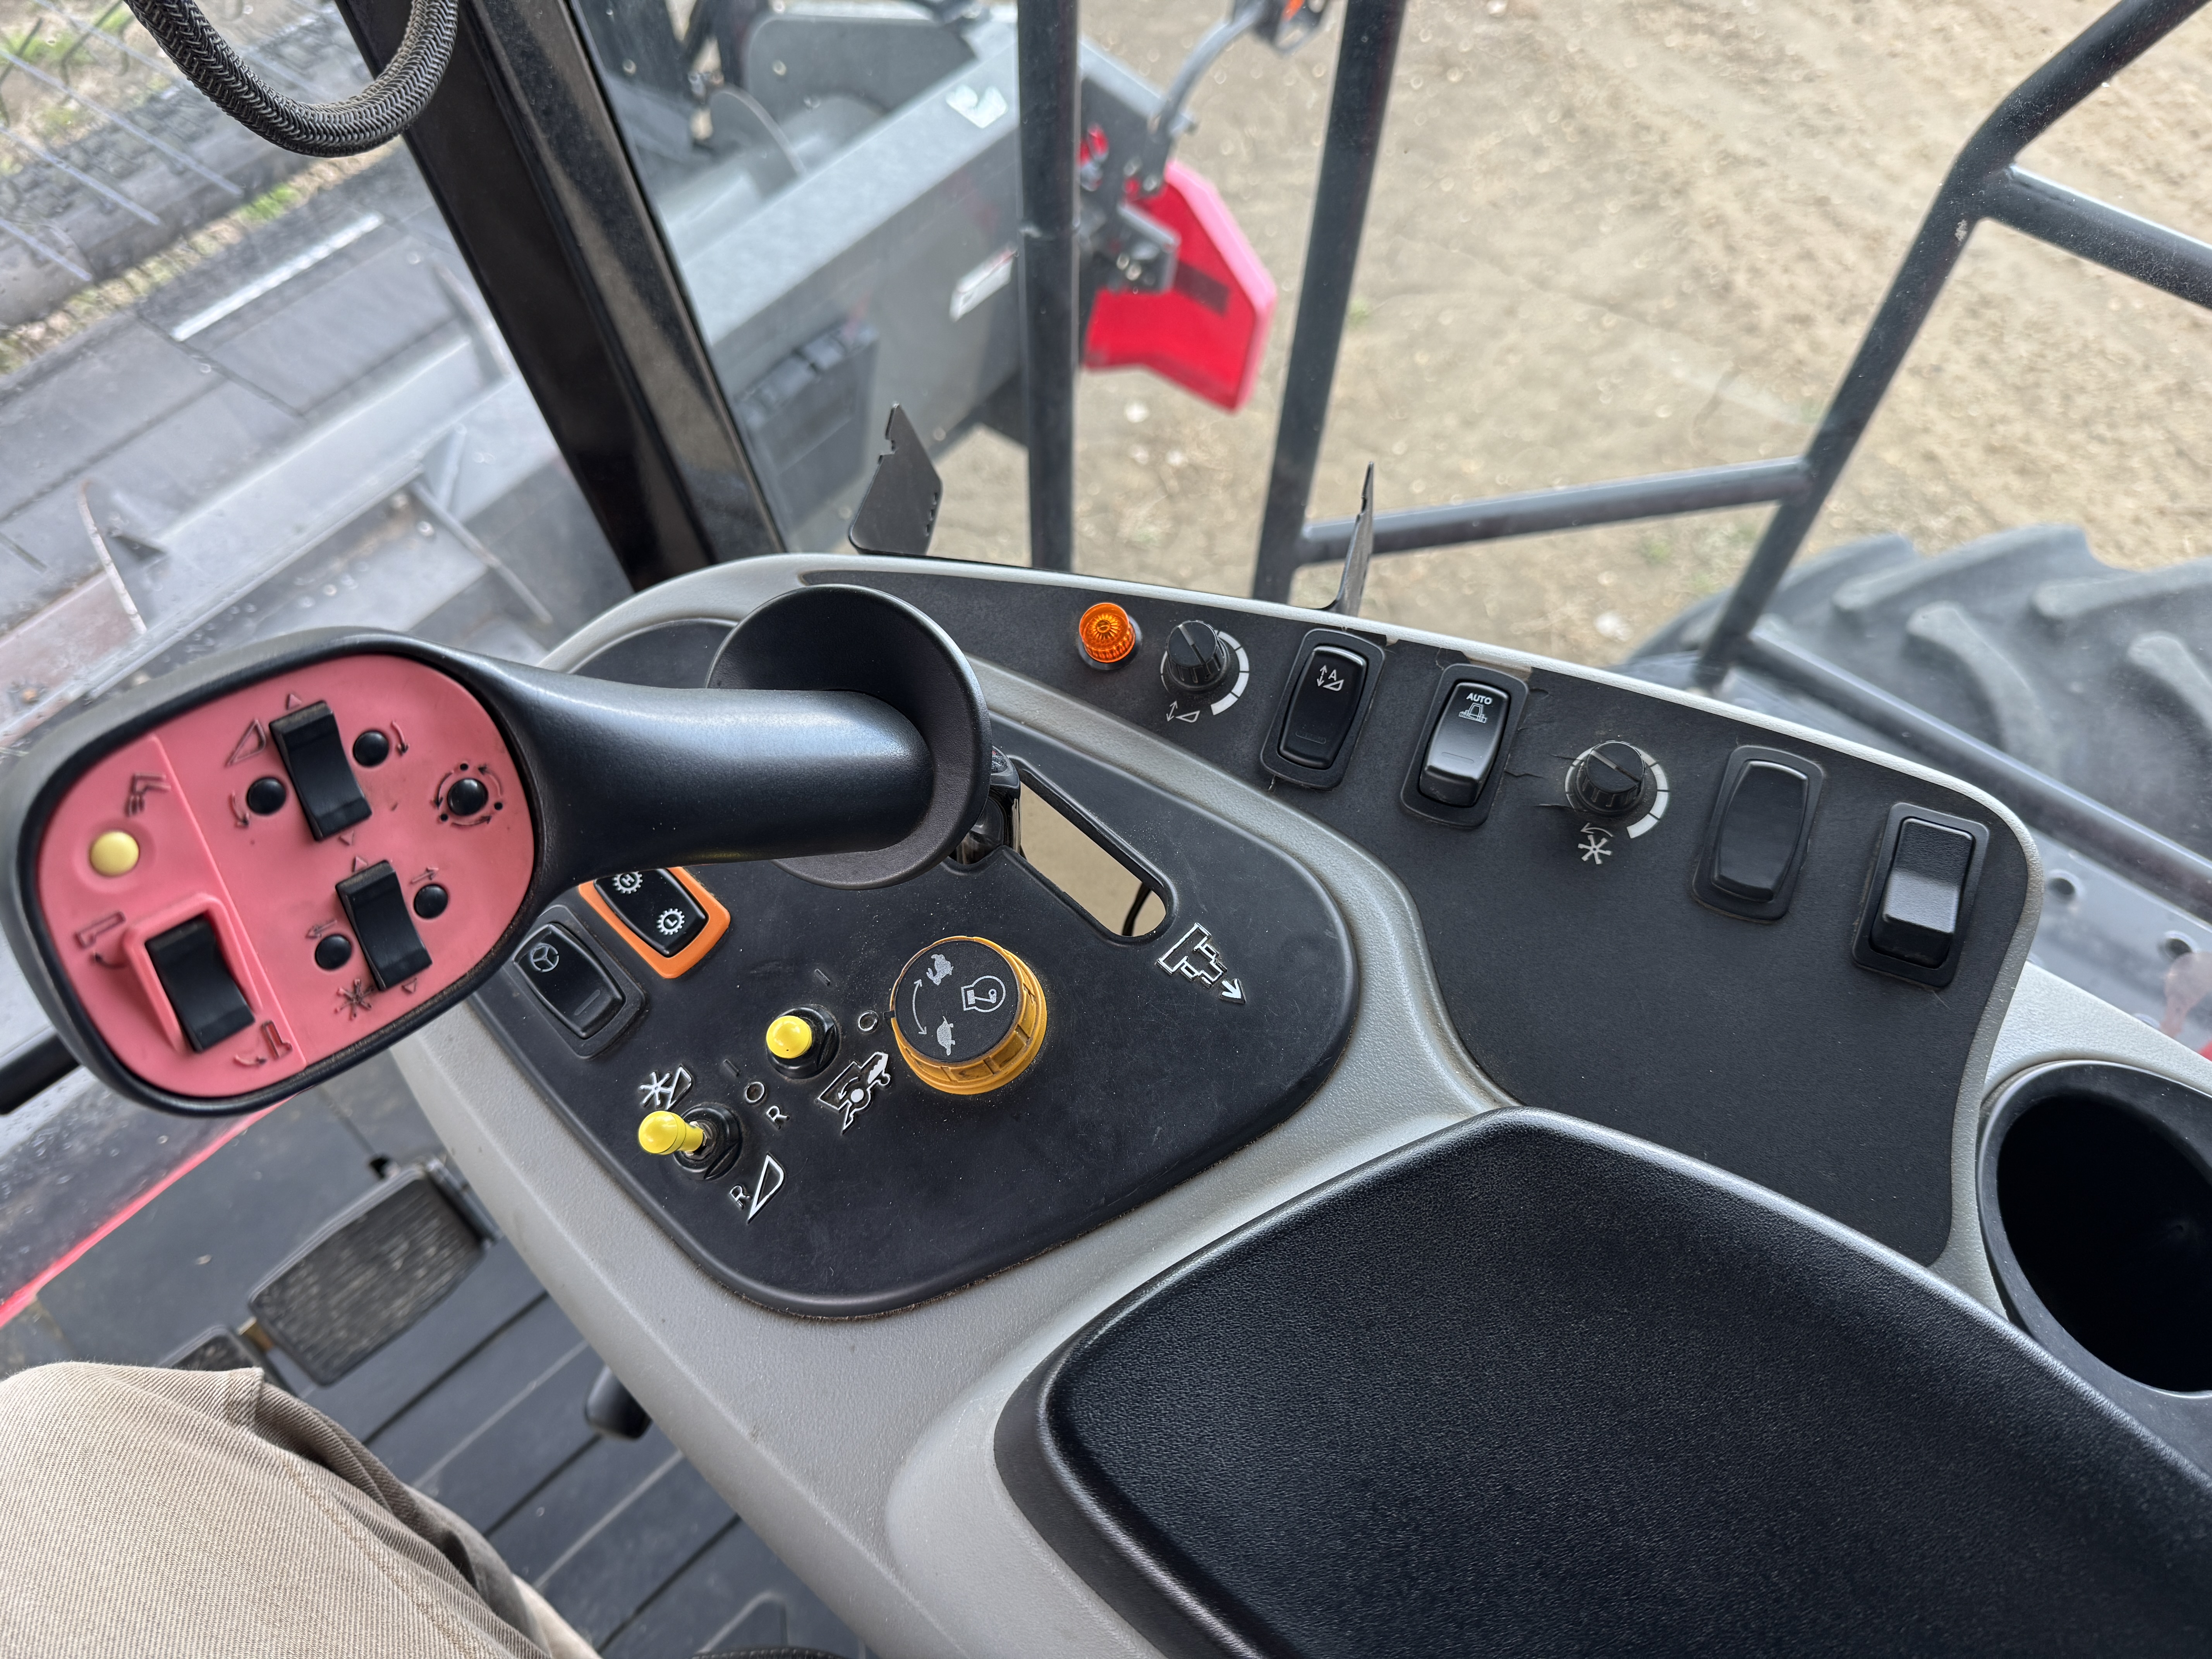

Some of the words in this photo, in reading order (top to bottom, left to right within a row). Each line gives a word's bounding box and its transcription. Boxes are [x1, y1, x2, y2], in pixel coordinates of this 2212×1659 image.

[1328, 670, 1337, 681] A
[1466, 692, 1492, 705] AUTO
[622, 874, 635, 886] H
[666, 918, 678, 927] L
[766, 1105, 790, 1129] R
[729, 1185, 751, 1209] R
